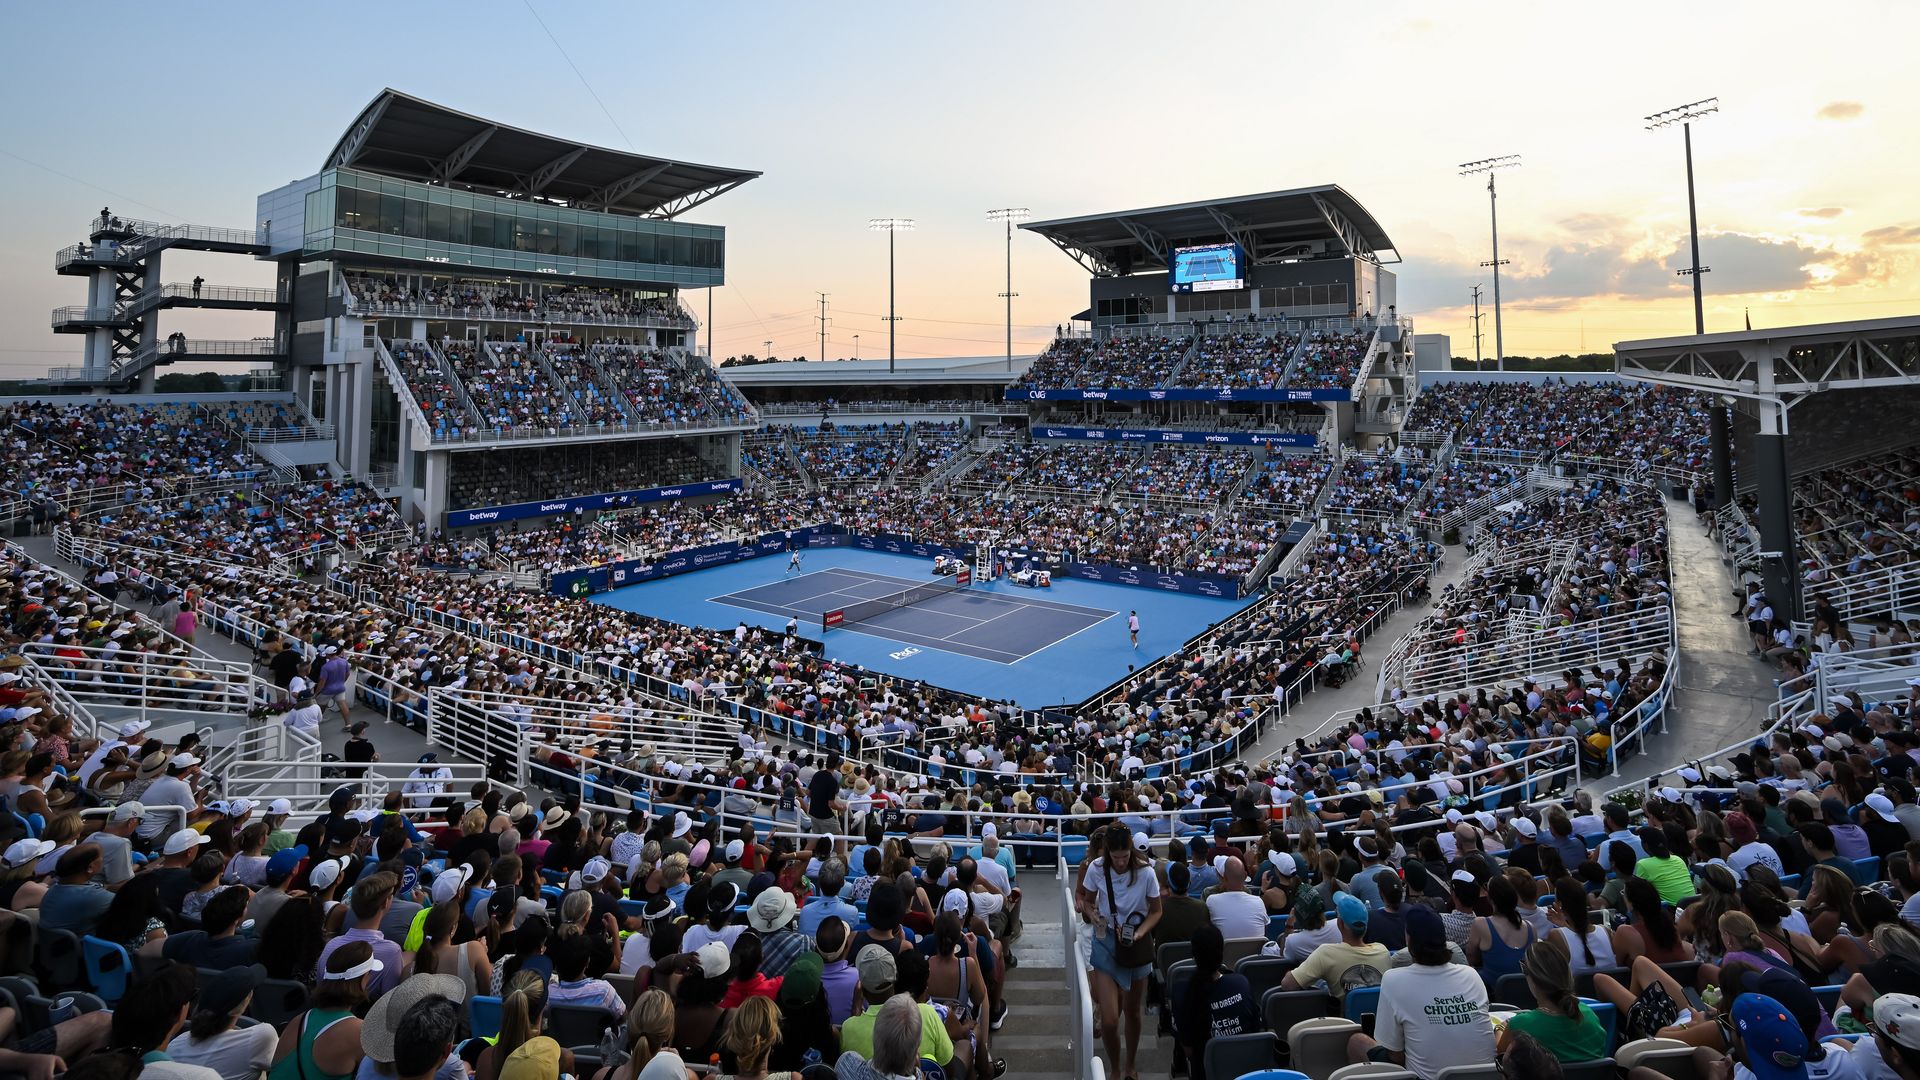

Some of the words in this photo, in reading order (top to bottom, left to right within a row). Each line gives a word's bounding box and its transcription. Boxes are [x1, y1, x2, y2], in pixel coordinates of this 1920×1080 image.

[1083, 391, 1108, 400] betway
[660, 487, 682, 497] betway
[711, 482, 731, 492] betway
[604, 495, 628, 504] beay
[540, 502, 568, 512] betway
[469, 510, 499, 522] betway
[889, 646, 922, 660] P&G
[1219, 993, 1243, 1009] DIRECTOR
[1433, 994, 1466, 1005] Served
[1424, 1001, 1479, 1015] CHUCKERS
[1443, 1013, 1471, 1025] CLUB
[1214, 1025, 1243, 1037] Autism
